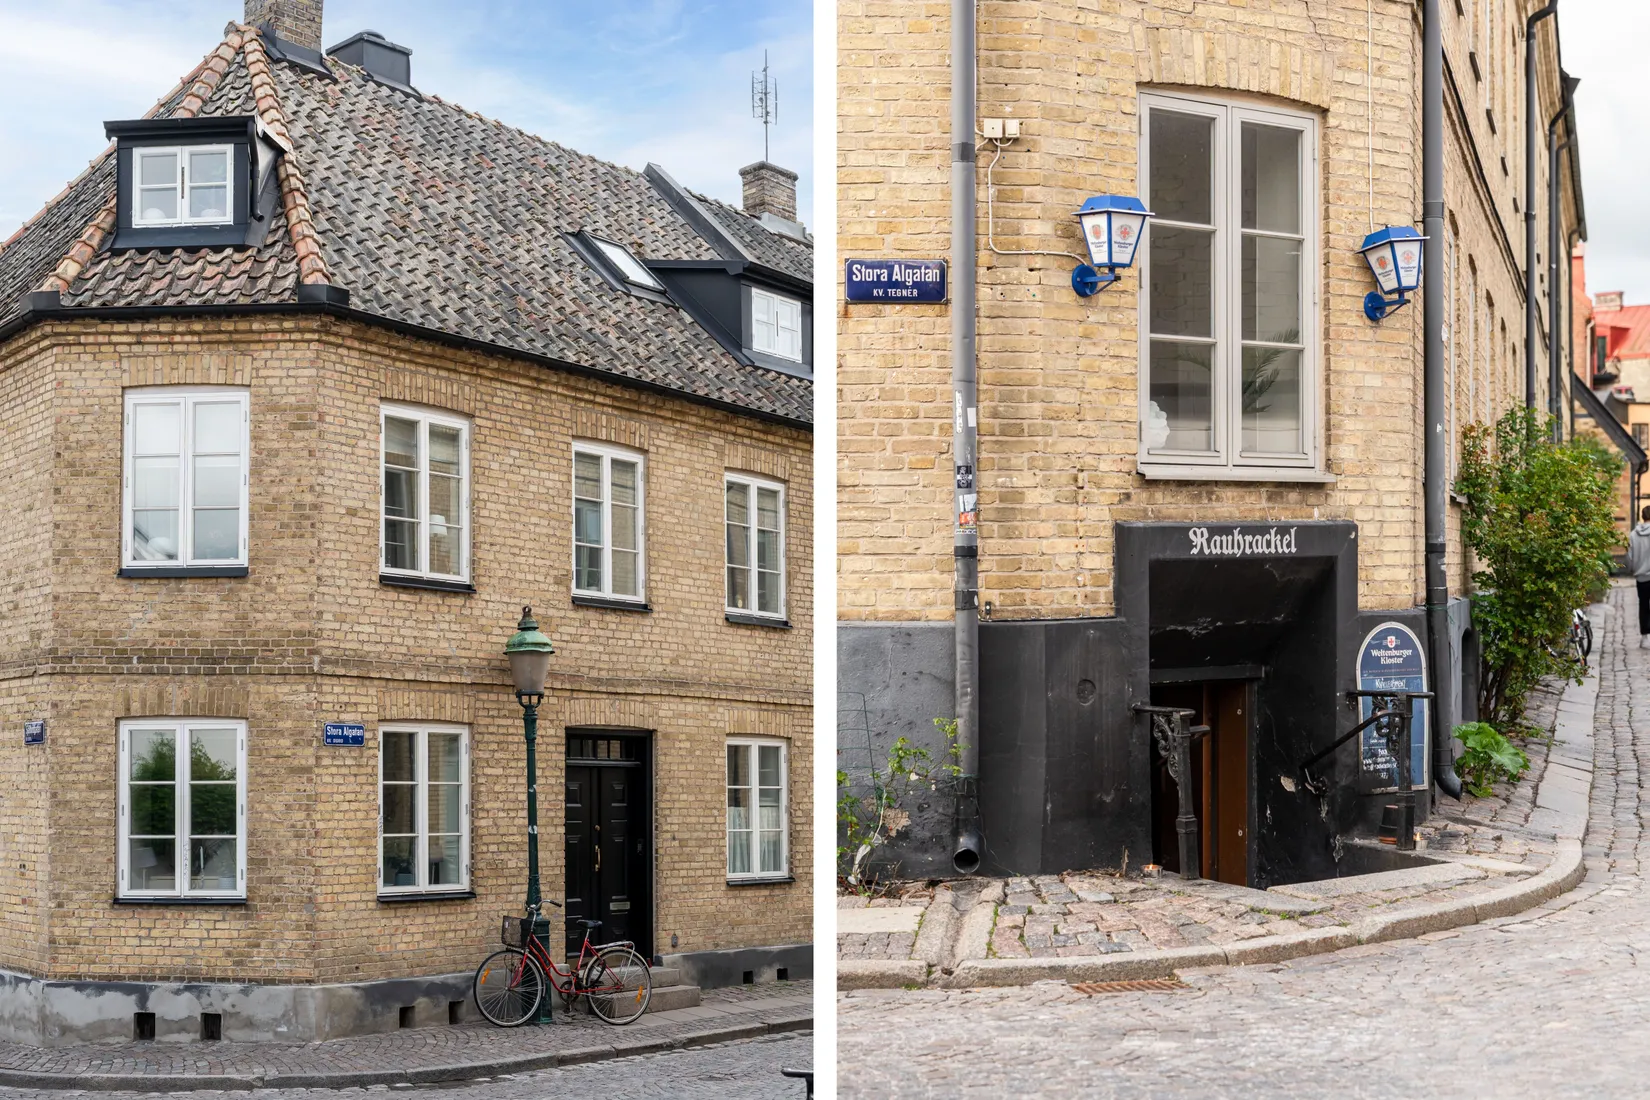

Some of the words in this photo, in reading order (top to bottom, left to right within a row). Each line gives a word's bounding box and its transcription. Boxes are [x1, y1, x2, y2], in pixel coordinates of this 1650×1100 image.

[852, 264, 888, 282] Stora
[892, 264, 940, 286] Algatan
[873, 288, 885, 297] KV.
[1188, 527, 1297, 557] Rauhrackel
[1371, 649, 1412, 658] Weltenburger
[327, 726, 342, 735] Stora
[343, 727, 363, 737] Algatan
